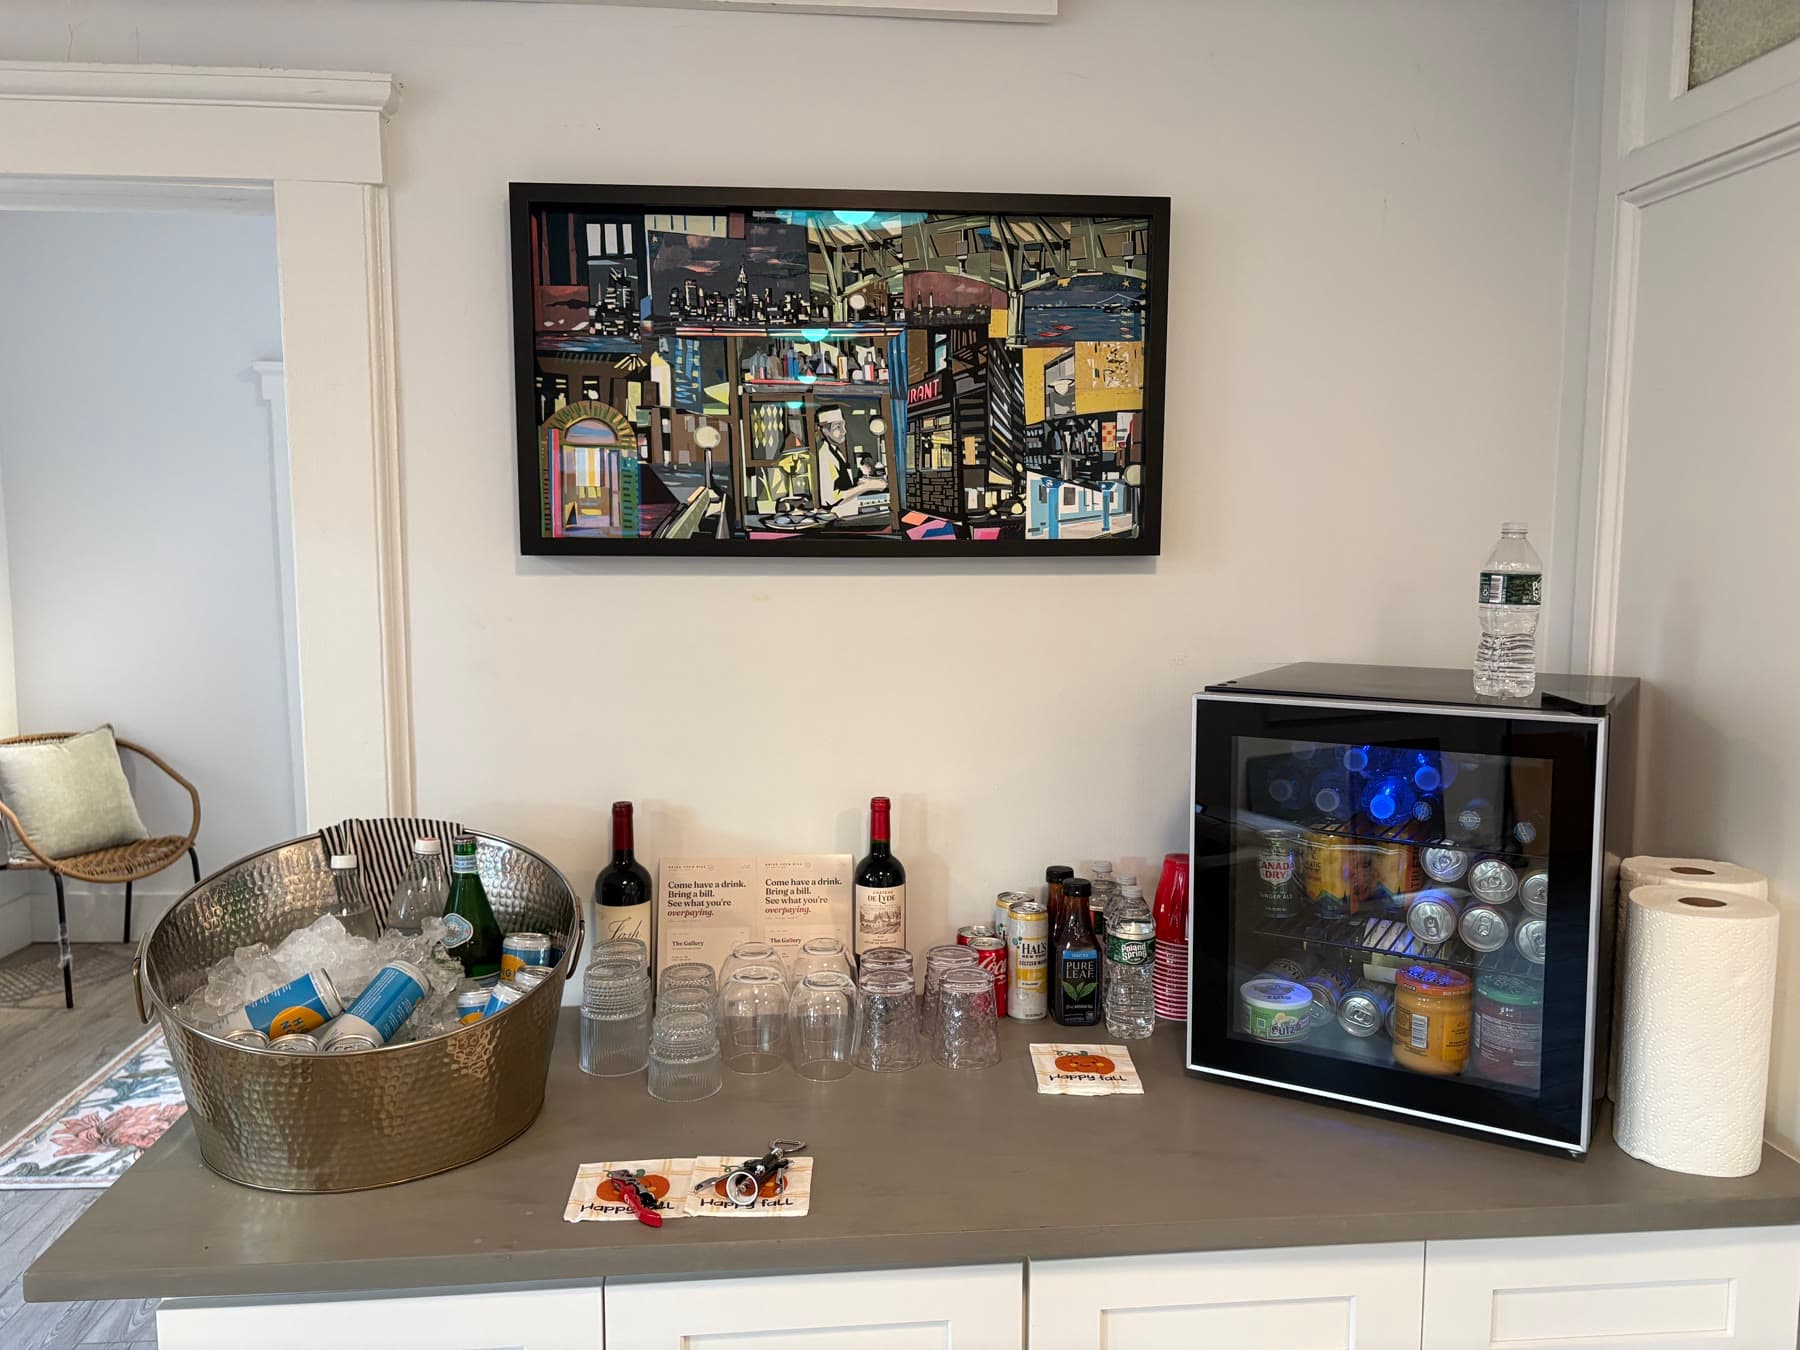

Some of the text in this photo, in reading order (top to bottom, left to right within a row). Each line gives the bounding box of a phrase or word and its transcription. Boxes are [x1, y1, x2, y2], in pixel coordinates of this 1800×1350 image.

[1265, 870, 1285, 879] DRY
[668, 881, 693, 889] Come
[721, 880, 746, 888] drink.
[791, 878, 810, 886] have
[818, 877, 842, 886] drink.
[668, 890, 691, 899] Bring
[700, 889, 715, 898] bill.
[766, 888, 788, 896] Bring
[796, 887, 811, 895] bill.
[684, 899, 704, 907] what
[706, 898, 732, 908] you're
[765, 897, 779, 905] See
[803, 896, 828, 905] you're
[667, 908, 714, 918] overpaying.
[765, 906, 811, 915] overpaying.
[782, 937, 802, 945] Gallery
[1121, 942, 1146, 952] Poland
[1122, 951, 1147, 961] Spring
[1066, 961, 1094, 969] PURE
[1066, 970, 1094, 978] LEAF
[761, 1198, 793, 1207] fall
